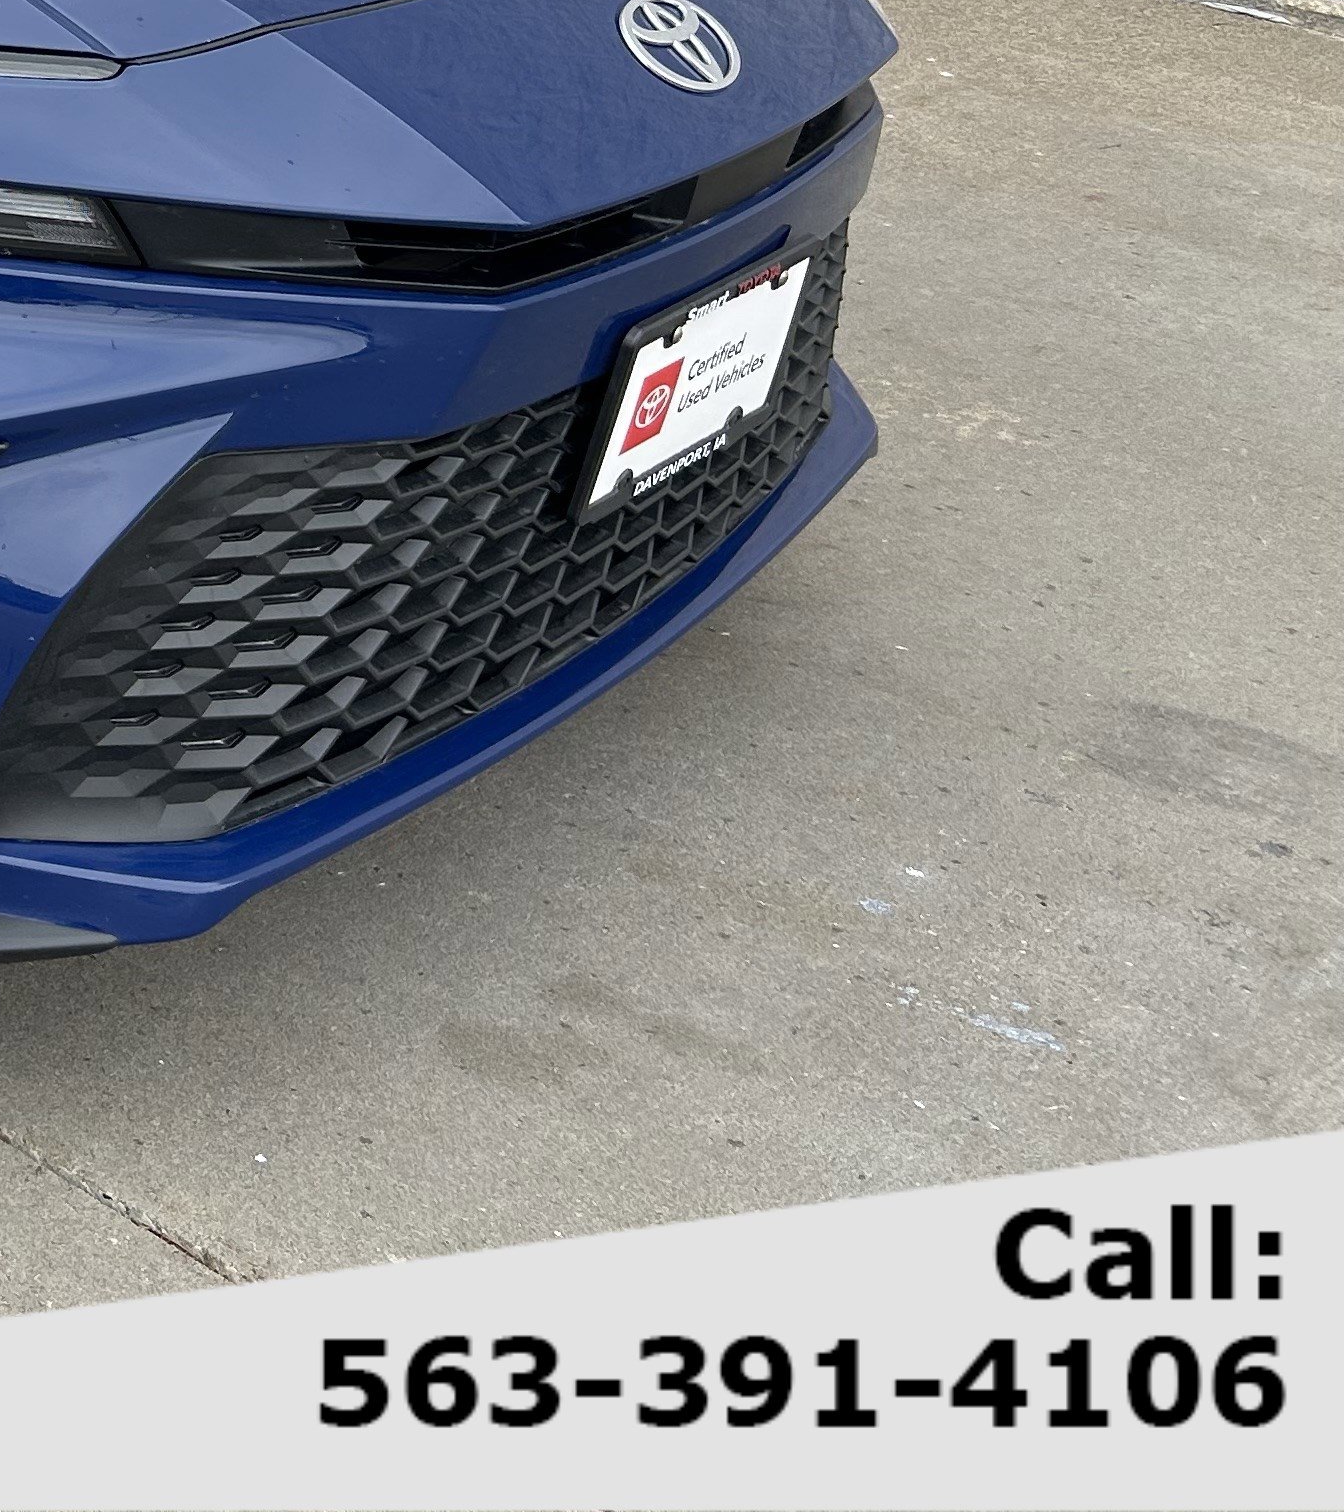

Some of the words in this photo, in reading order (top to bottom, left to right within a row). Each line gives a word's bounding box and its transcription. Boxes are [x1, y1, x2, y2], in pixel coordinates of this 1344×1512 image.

[687, 290, 730, 322] Smart
[677, 377, 714, 413] Used
[714, 353, 767, 394] Vehicles
[687, 332, 748, 381] Certified
[632, 441, 712, 497] DAVENPORT,
[713, 433, 727, 452] IA
